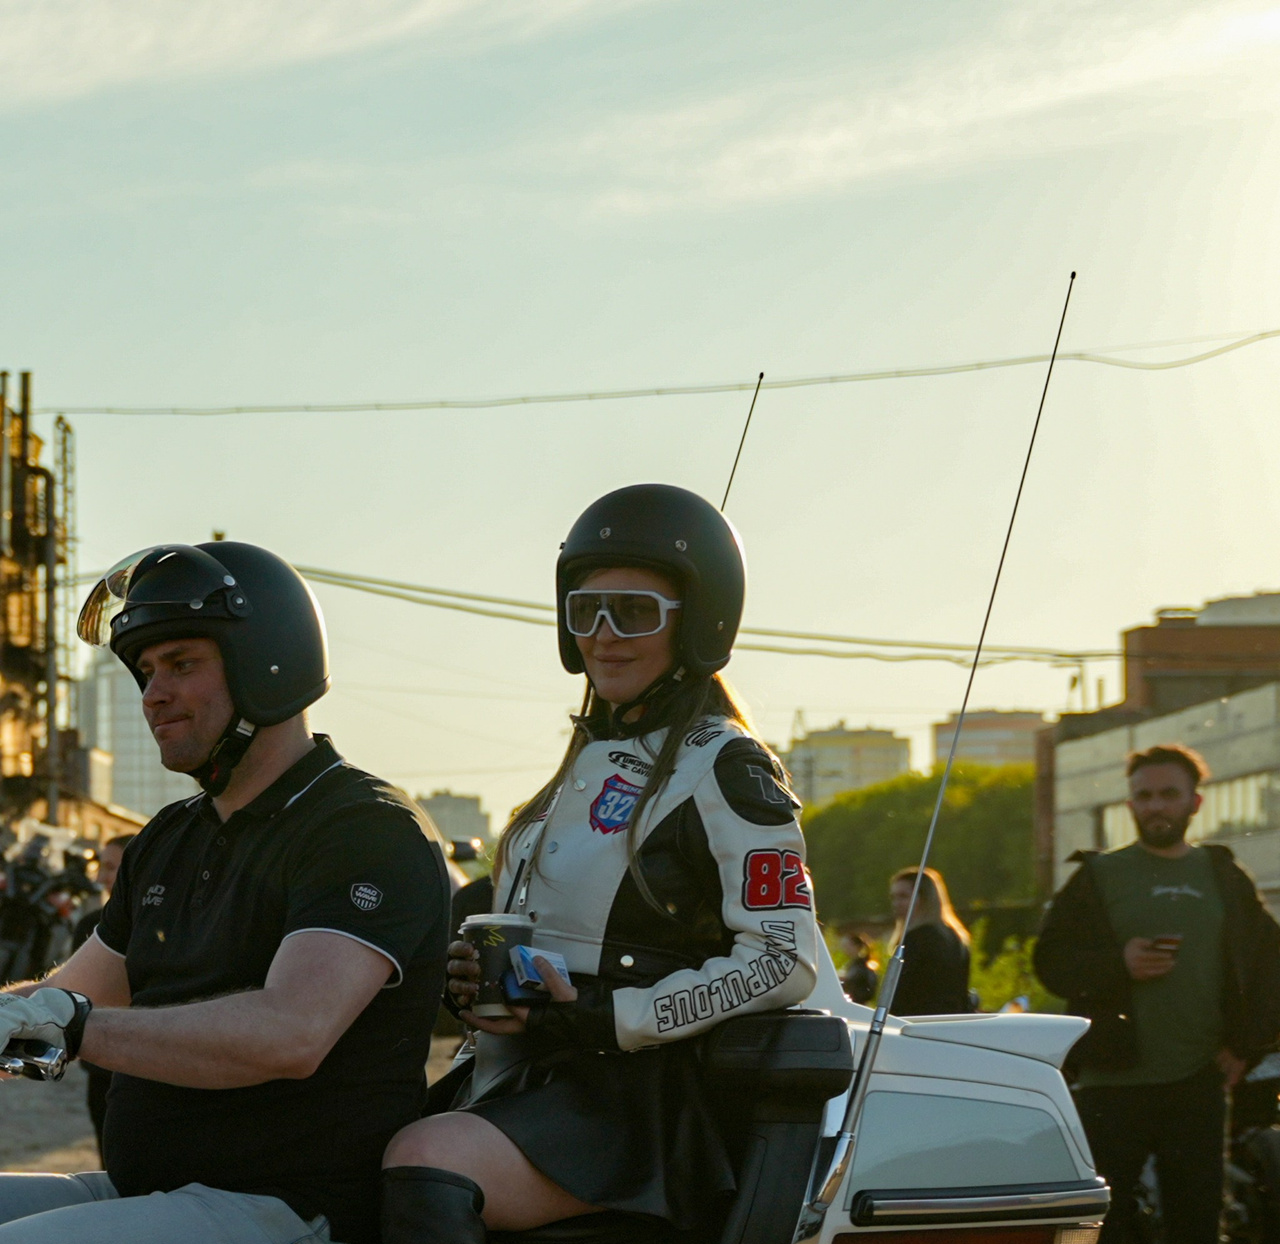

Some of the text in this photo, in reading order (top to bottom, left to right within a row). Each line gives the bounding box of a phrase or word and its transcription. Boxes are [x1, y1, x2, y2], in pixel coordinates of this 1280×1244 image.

[741, 848, 812, 912] 82
[355, 890, 378, 903] WAVE
[358, 886, 378, 897] MAD
